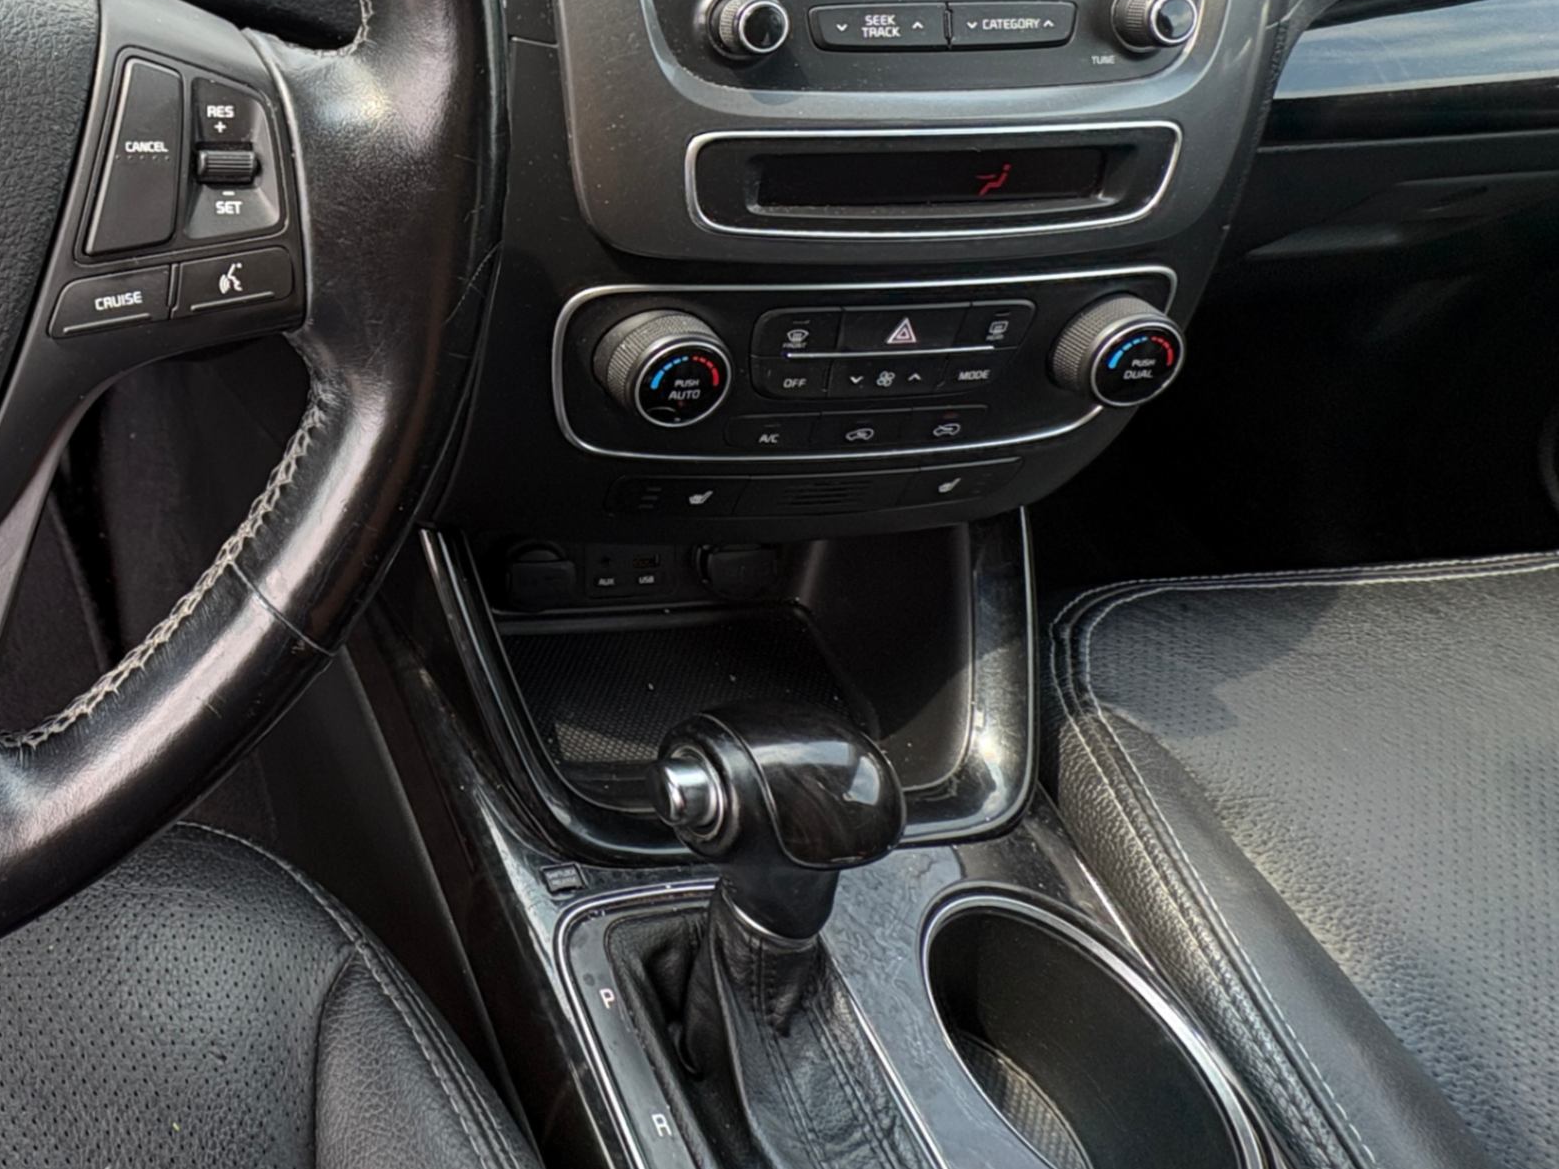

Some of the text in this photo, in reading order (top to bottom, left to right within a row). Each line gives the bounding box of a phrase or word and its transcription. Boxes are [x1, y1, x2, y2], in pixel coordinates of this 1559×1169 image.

[864, 15, 896, 26] SEEK
[982, 18, 1040, 31] CATEGORY
[861, 26, 900, 38] TRACK
[207, 105, 234, 118] RES
[125, 141, 169, 153] CANCEL
[215, 200, 243, 214] SET
[94, 291, 143, 310] CRUISE
[1131, 358, 1157, 368] PUSH
[958, 369, 990, 381] MODE
[1123, 369, 1154, 380] DUAL
[674, 378, 700, 388] PUSH
[783, 377, 807, 389] OFF
[668, 388, 701, 401] AUTO
[759, 433, 780, 444] A/C
[638, 575, 655, 584] USB
[599, 987, 615, 1009] P
[651, 1112, 672, 1137] R
